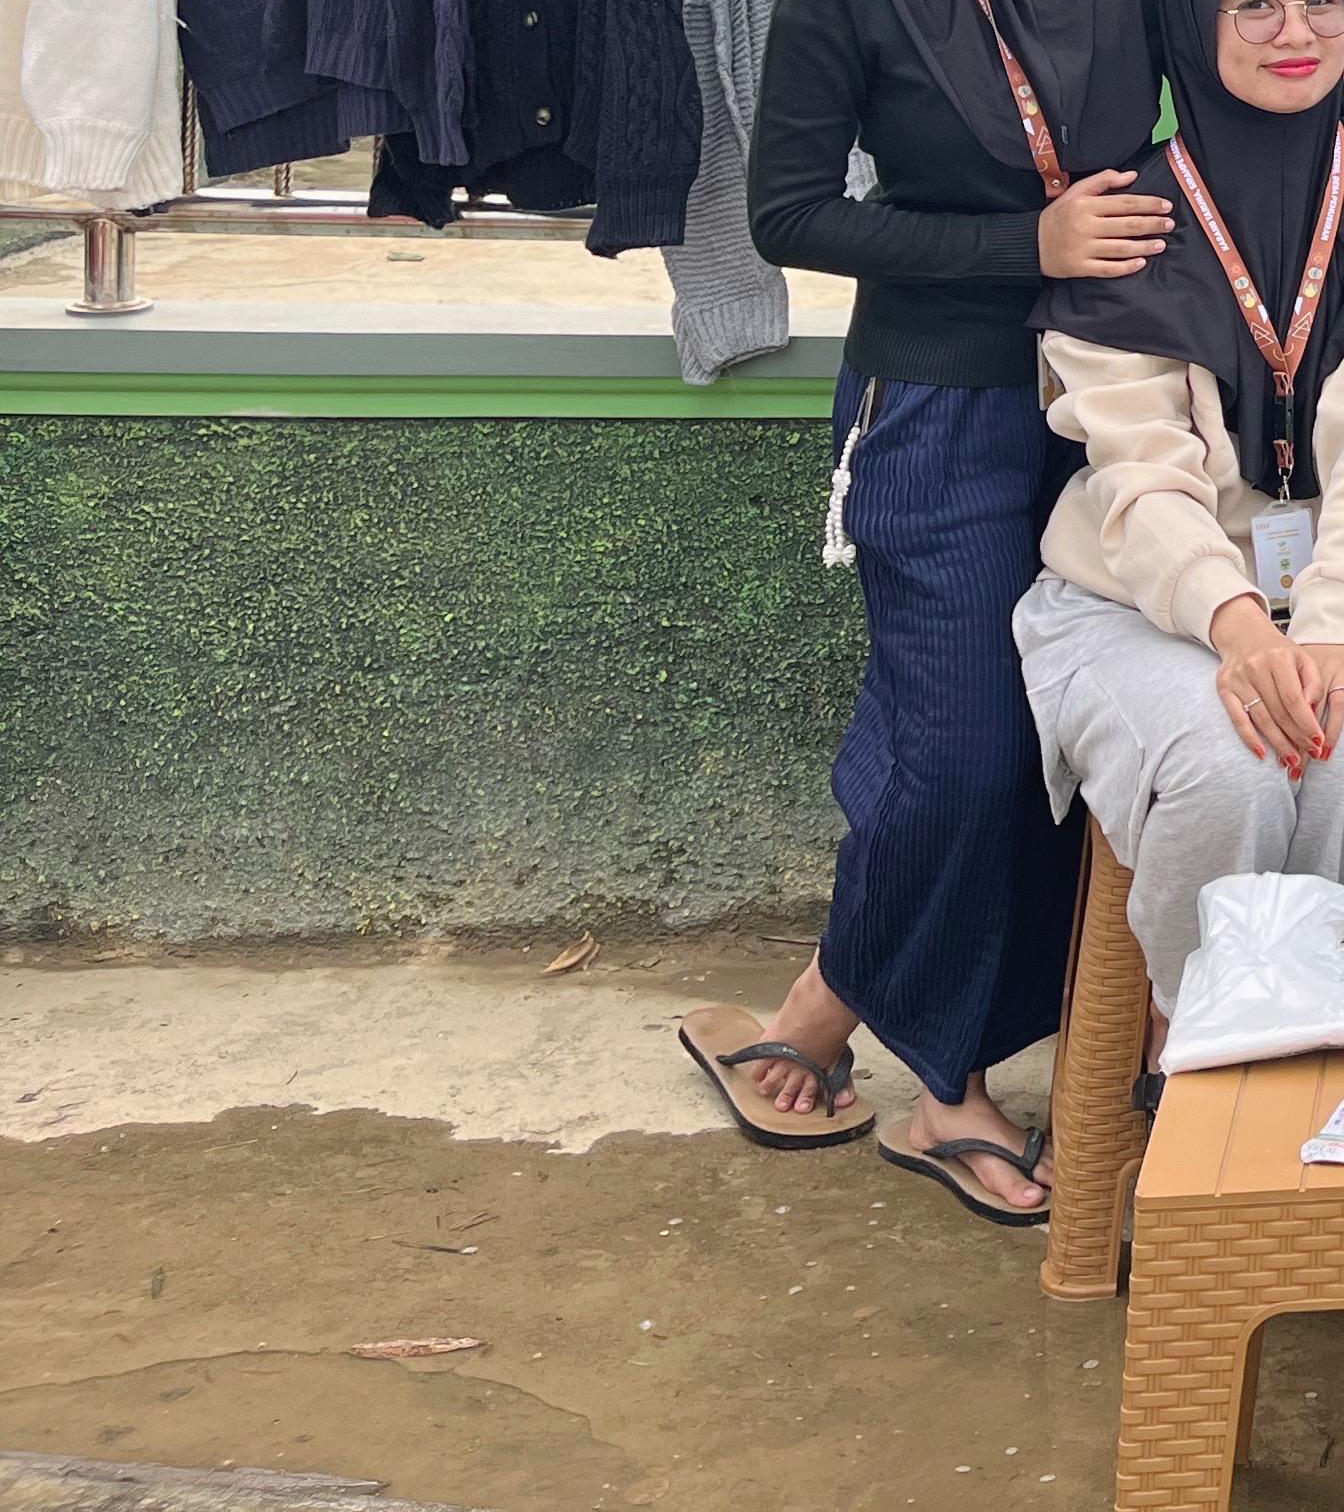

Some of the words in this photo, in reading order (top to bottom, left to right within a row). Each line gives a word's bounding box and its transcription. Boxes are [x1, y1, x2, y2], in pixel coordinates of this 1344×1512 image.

[1329, 175, 1340, 195] DESA
[1190, 188, 1215, 222] TARUNA,
[1207, 219, 1229, 252] KARANG
